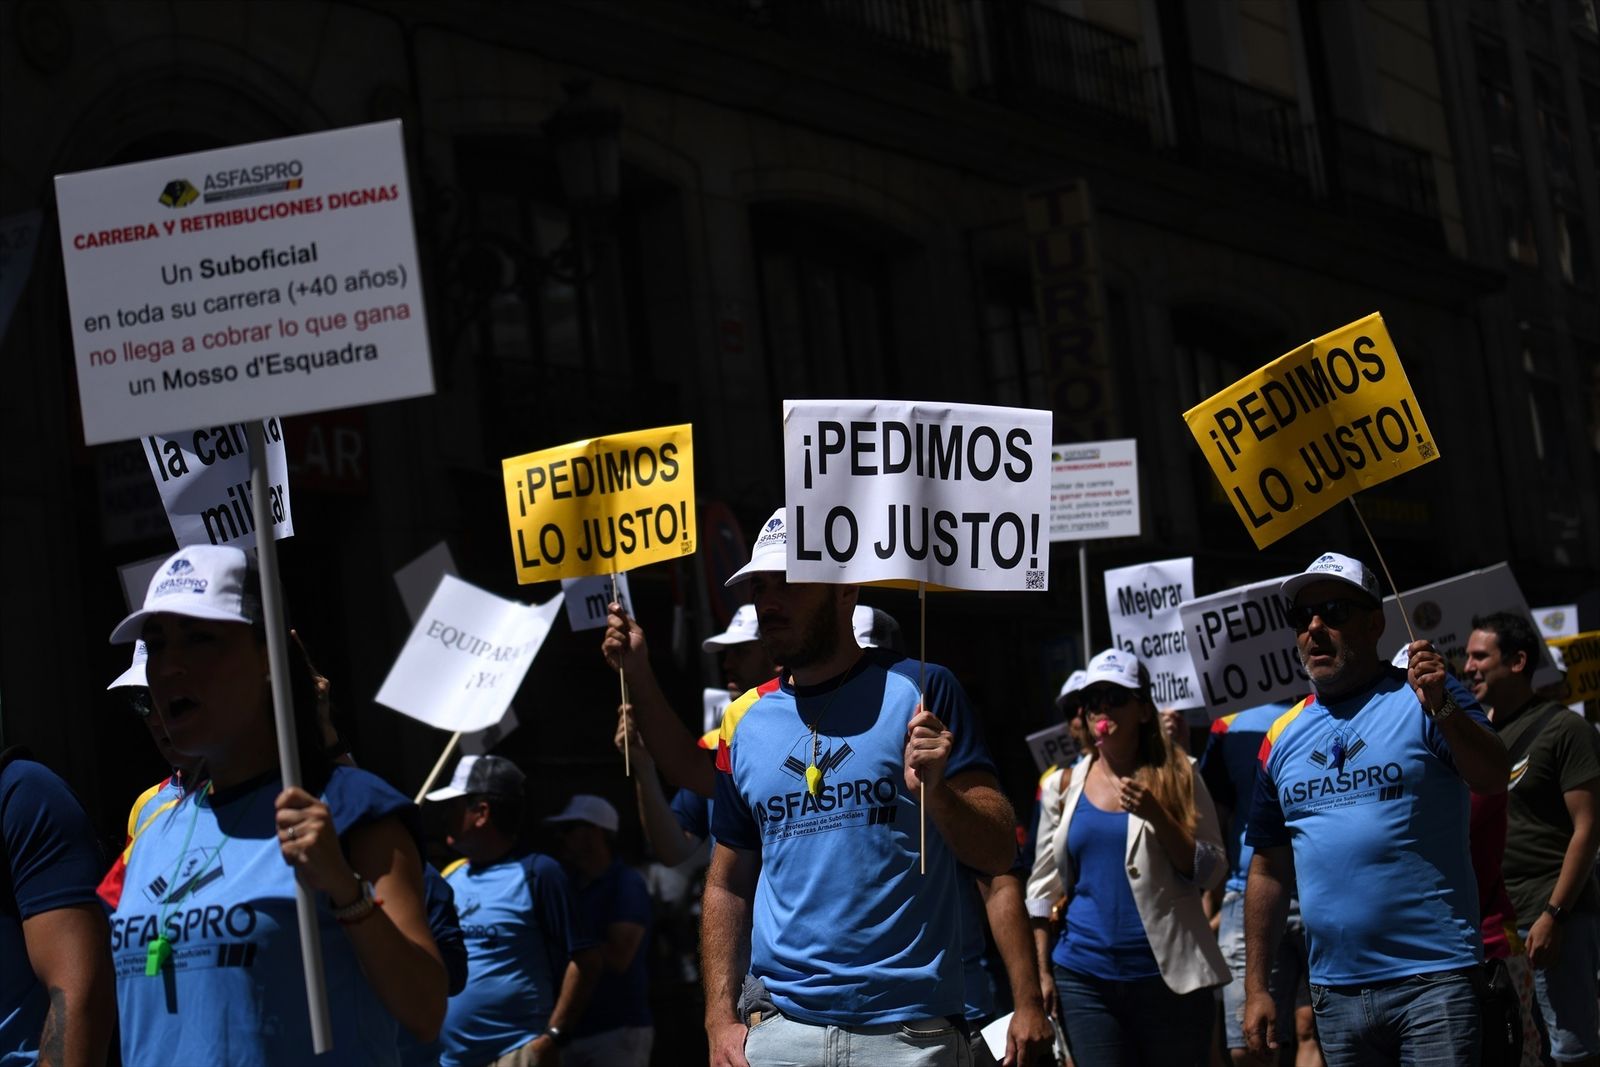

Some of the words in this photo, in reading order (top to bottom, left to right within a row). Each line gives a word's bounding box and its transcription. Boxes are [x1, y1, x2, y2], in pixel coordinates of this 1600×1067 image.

[203, 160, 303, 191] ASFASPRO
[74, 223, 160, 250] CARRERA
[163, 221, 175, 236] Y
[181, 195, 323, 233] RETRIBUCIONES
[328, 185, 399, 210] DIGNAS
[161, 265, 193, 285] Un
[200, 243, 318, 280] Suboficial
[84, 312, 110, 332] en
[117, 304, 165, 328] toda
[171, 299, 196, 319] su
[203, 287, 280, 313] carrera
[287, 275, 337, 304] (+40
[344, 265, 408, 294] años)
[90, 346, 116, 367] no
[123, 335, 175, 363] llega
[181, 334, 196, 352] a
[202, 321, 272, 351] cobrar
[279, 317, 299, 338] lo
[305, 312, 347, 337] que
[353, 303, 411, 332] gana
[129, 375, 155, 396] un
[162, 362, 239, 391] Mosso
[245, 342, 378, 380] d'Esquadra
[1210, 336, 1386, 472] ¡PEDIMOS
[149, 435, 190, 482] la
[287, 424, 364, 481] AR
[517, 443, 679, 517] ¡PEDIMOS
[803, 421, 1033, 489] ¡PEDIMOS
[1234, 468, 1295, 528] LO
[1299, 399, 1425, 494] JUSTO!
[517, 523, 565, 568] LO
[577, 501, 688, 561] JUSTO!
[796, 506, 858, 562] LO
[874, 503, 1040, 569] JUSTO!
[1117, 583, 1183, 619] Mejorar
[1117, 635, 1135, 655] la
[1204, 664, 1248, 705] LO
[755, 777, 897, 827] ASFASPRO
[1283, 762, 1403, 808] ASFASPRO
[110, 903, 256, 953] SFASPRO
